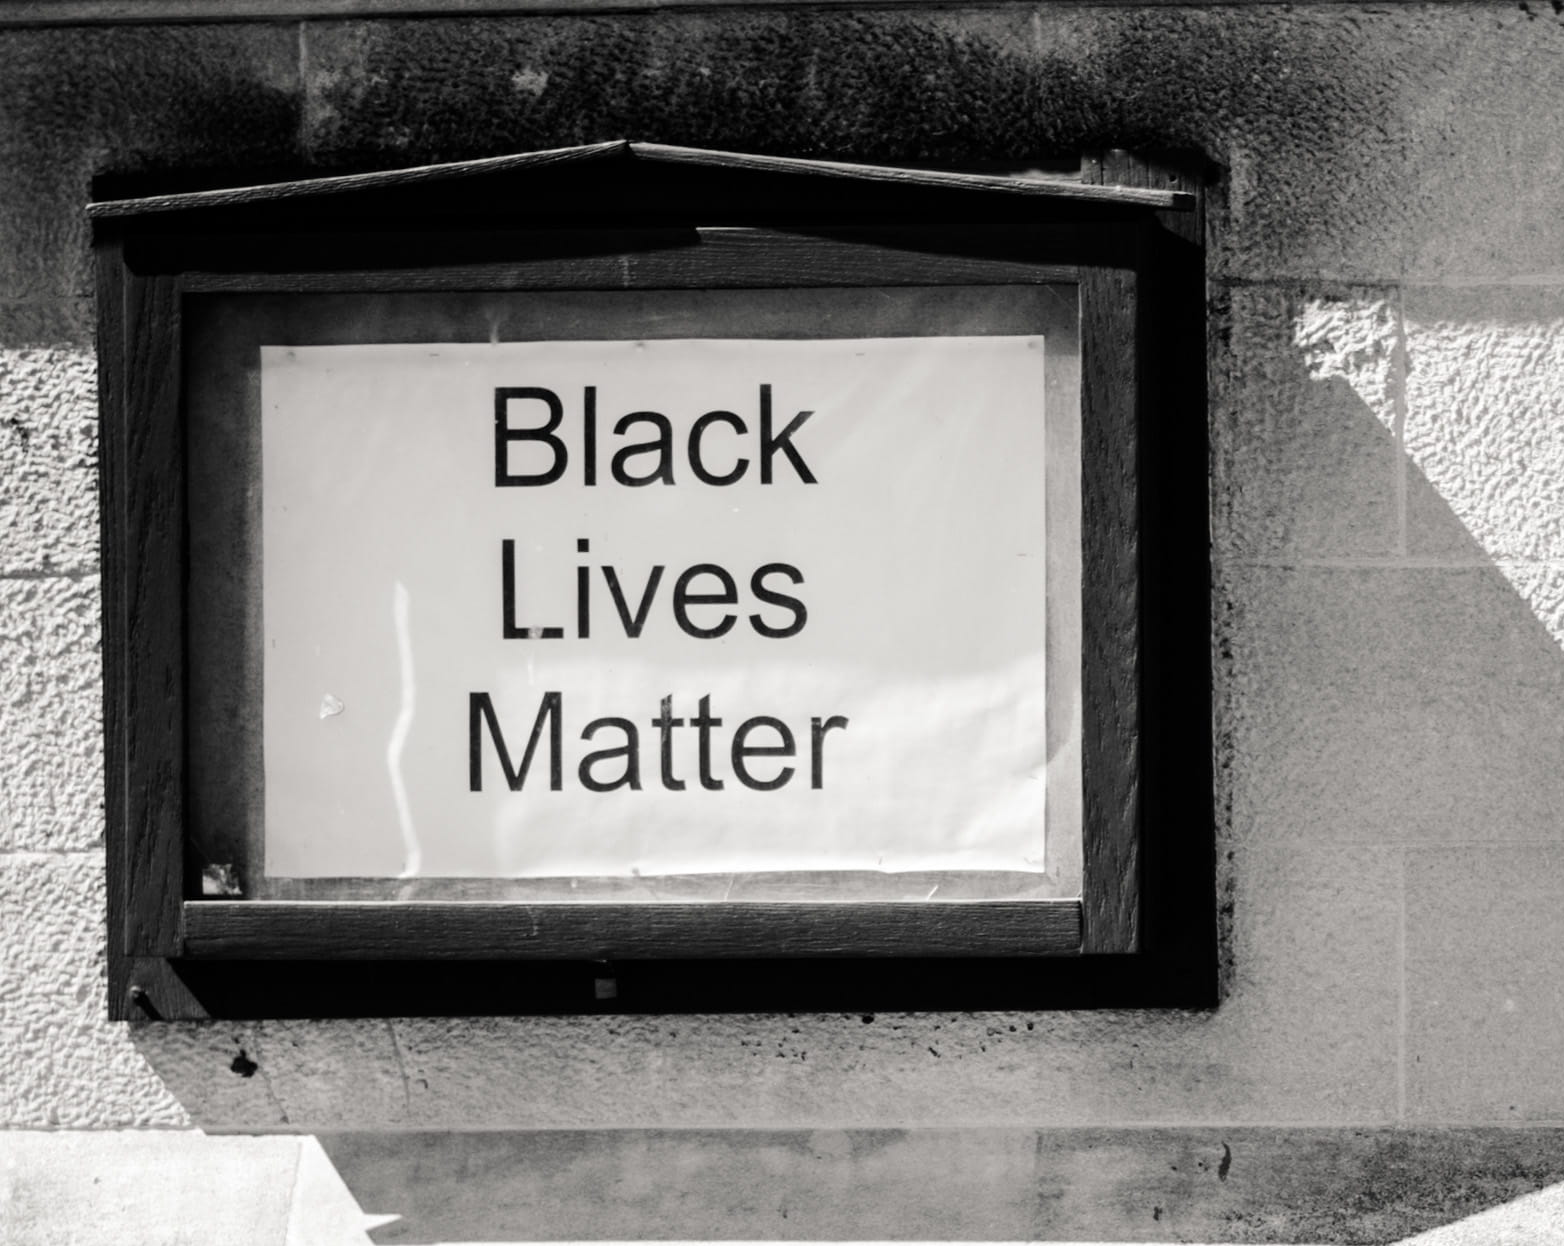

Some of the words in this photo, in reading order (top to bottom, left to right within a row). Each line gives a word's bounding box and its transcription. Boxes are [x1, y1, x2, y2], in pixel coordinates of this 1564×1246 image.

[493, 383, 818, 488] Black
[501, 538, 808, 640] Lives
[468, 690, 848, 792] Matter
